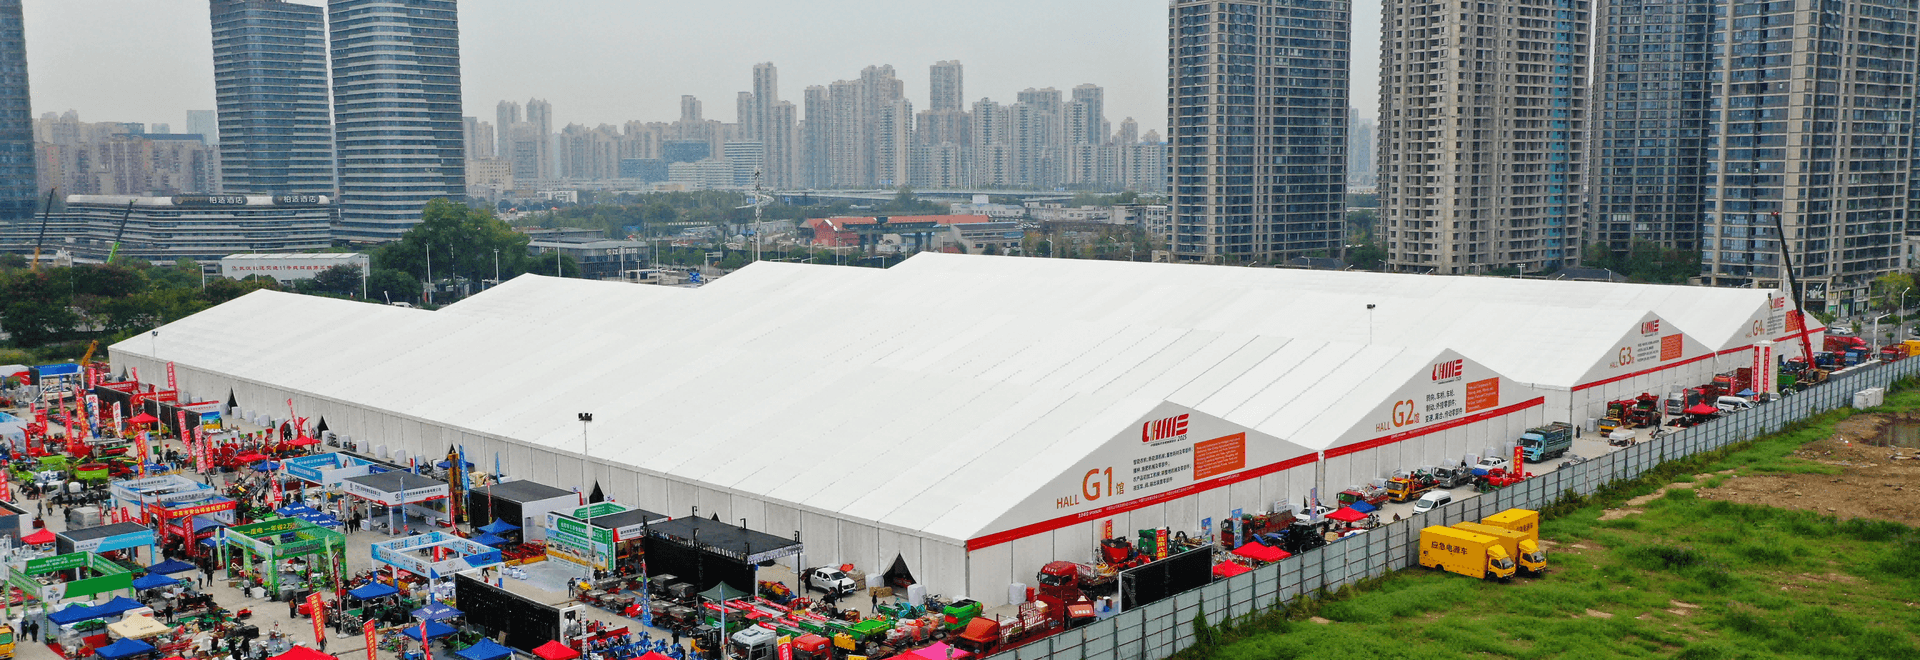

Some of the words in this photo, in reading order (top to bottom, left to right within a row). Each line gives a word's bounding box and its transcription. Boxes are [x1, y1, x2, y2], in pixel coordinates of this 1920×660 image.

[1619, 346, 1632, 366] G3
[1376, 421, 1391, 433] HALL
[1392, 399, 1414, 428] G2
[1056, 494, 1080, 510] HALL
[1082, 466, 1113, 502] G1
[1116, 481, 1125, 495] 馆
[1431, 540, 1469, 556] 应急电源车
